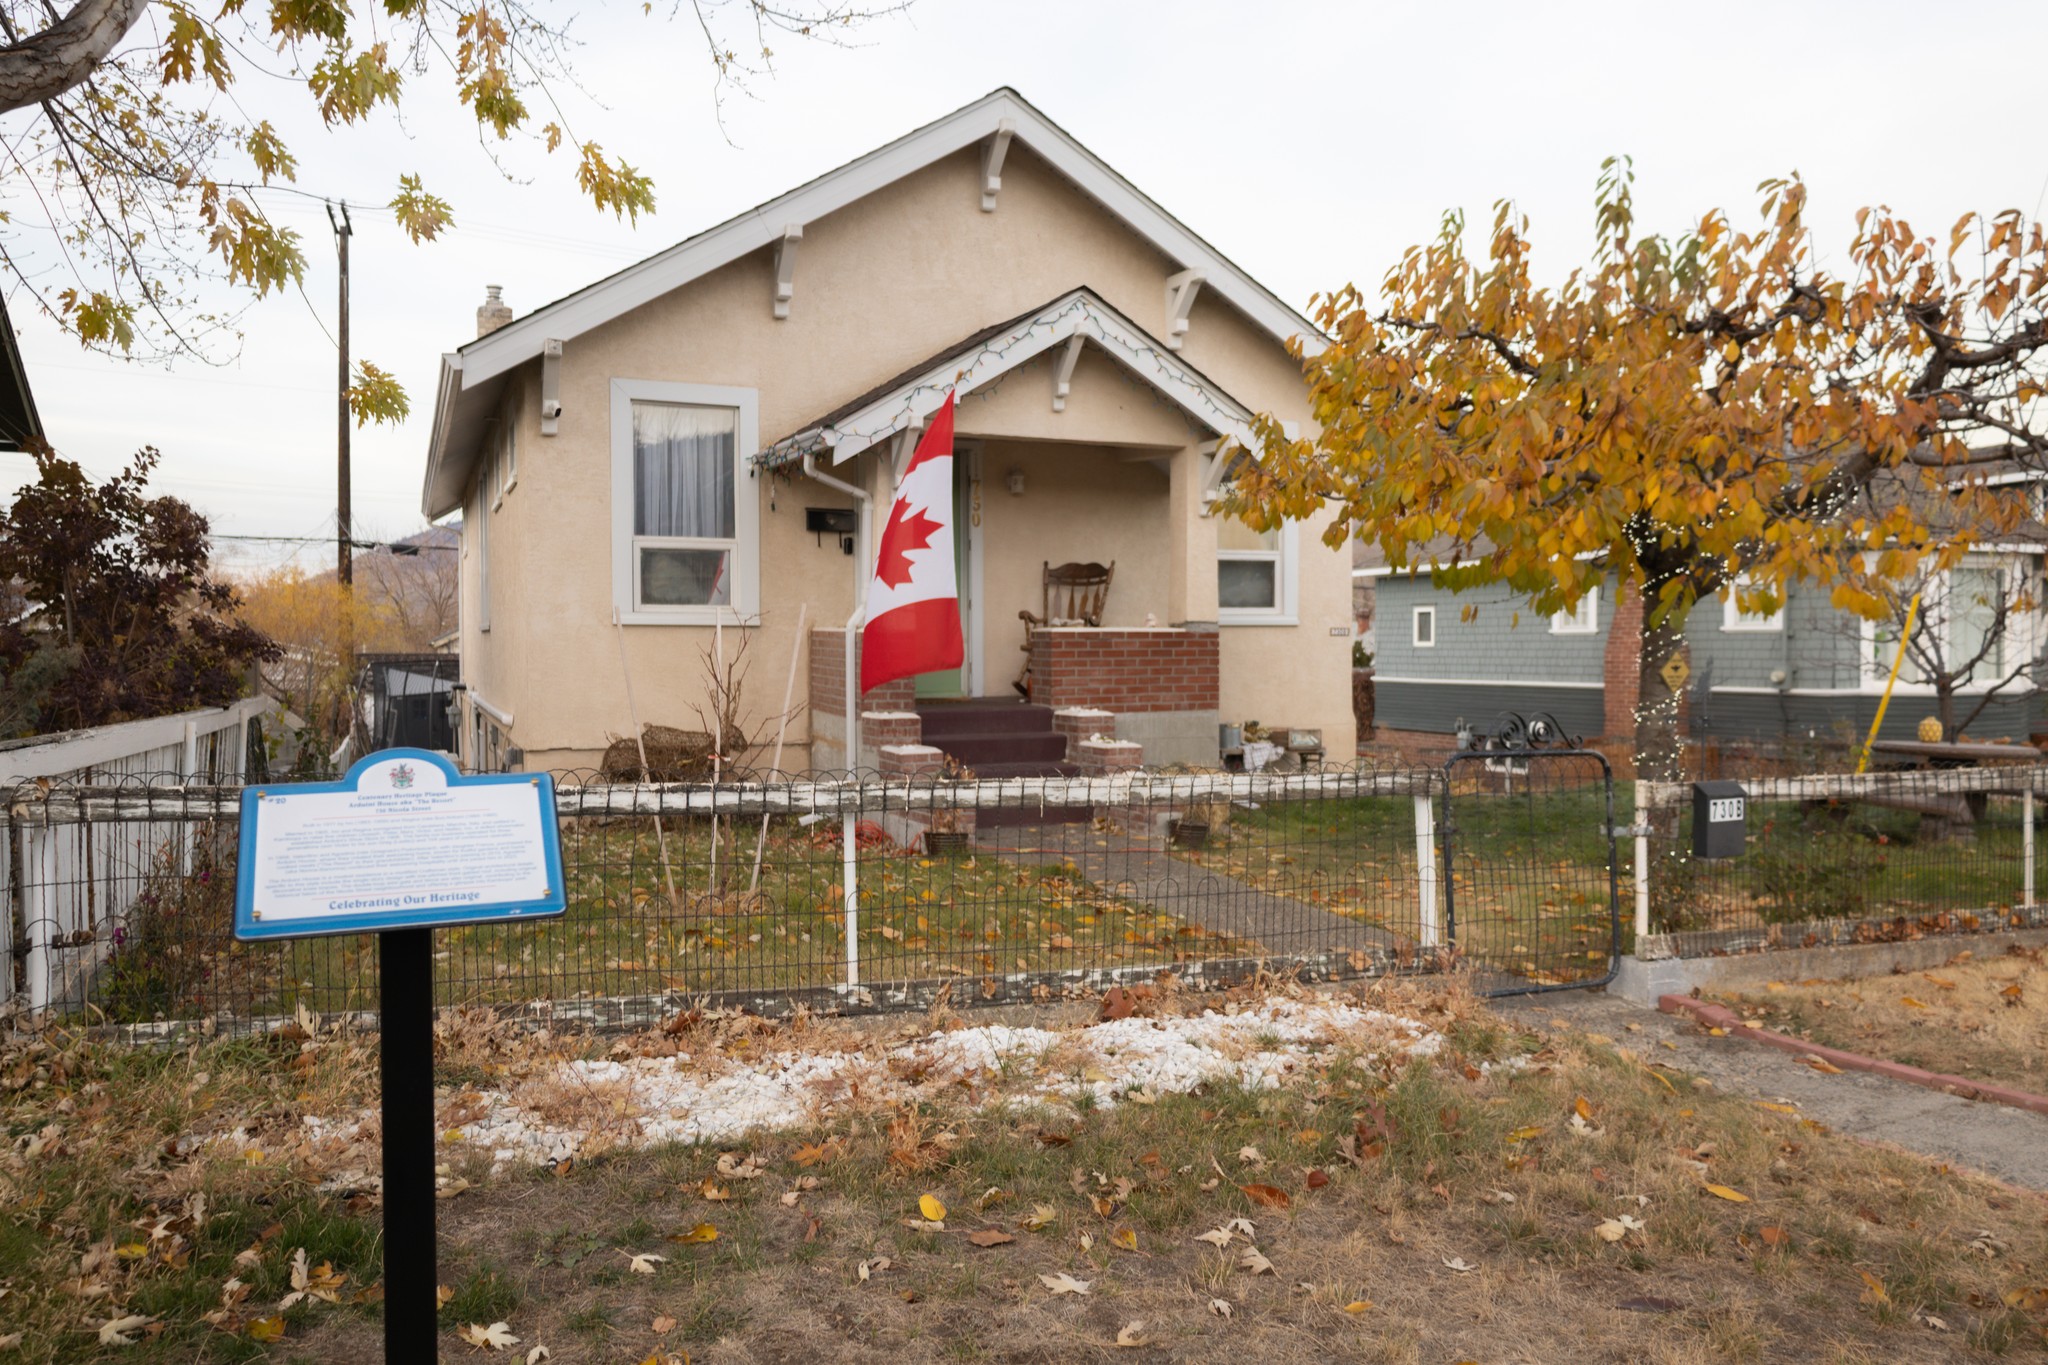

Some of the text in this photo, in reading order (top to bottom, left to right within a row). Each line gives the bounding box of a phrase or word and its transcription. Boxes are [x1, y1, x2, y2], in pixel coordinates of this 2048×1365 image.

[1712, 800, 1742, 819] 730B
[329, 891, 480, 911] Celebrating Our Heritage
